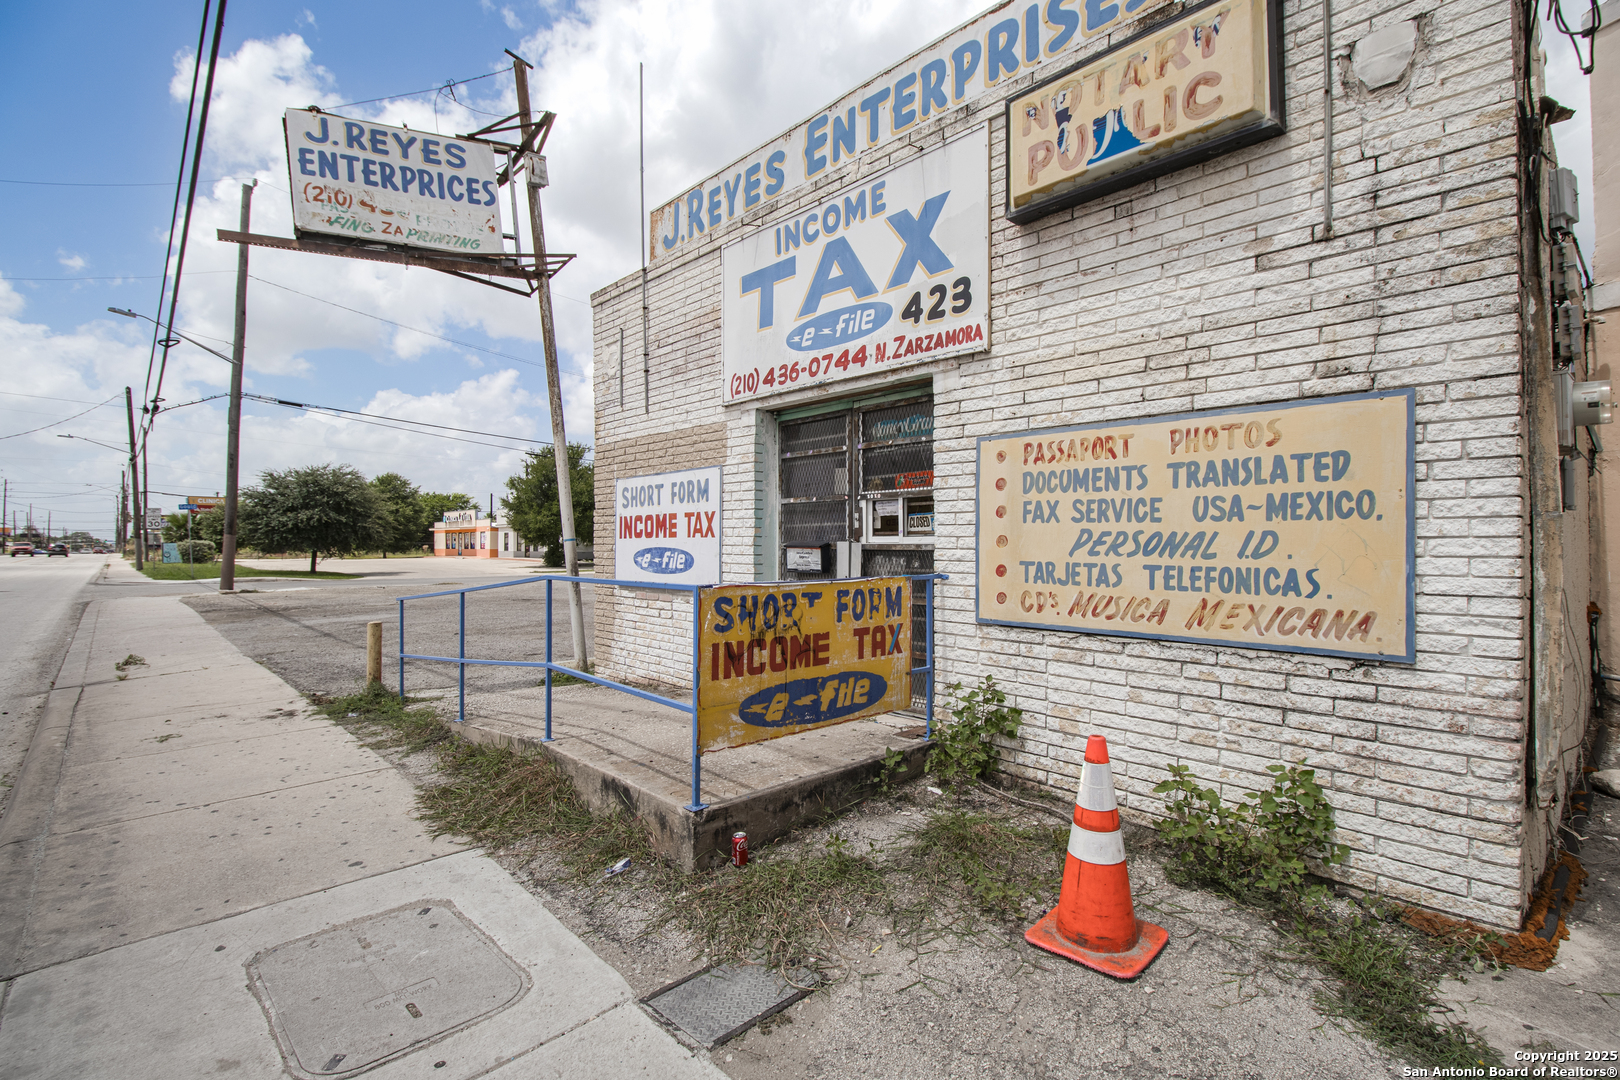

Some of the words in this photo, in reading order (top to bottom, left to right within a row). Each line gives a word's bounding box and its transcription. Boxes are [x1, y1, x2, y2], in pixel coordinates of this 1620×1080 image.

[804, 0, 1154, 179] ENTERPRISE
[1022, 6, 1231, 137] NOTARY
[1027, 71, 1223, 186] PULIC
[298, 147, 497, 207] ENTERPRICES
[775, 180, 887, 257] INCOME
[739, 190, 955, 333] TAX
[900, 276, 973, 327] 423
[1022, 433, 1135, 466] PASSAPORT
[1169, 417, 1283, 455] PHOTOS
[621, 483, 664, 509] SHORT
[671, 478, 710, 504] FORM
[1022, 464, 1149, 494] DOCUMENTS
[1166, 449, 1352, 489] TRANSLATED
[147, 520, 160, 528] 30
[619, 513, 678, 539] INCOME
[684, 511, 716, 538] TAX
[909, 516, 931, 529] CLOSED
[1022, 499, 1060, 524] FAX
[1070, 497, 1163, 524] SERVICE
[1068, 528, 1219, 560] PERSONAL
[1019, 560, 1123, 588] TARJETAS
[1142, 565, 1333, 600] TELEFONICAS.
[712, 591, 824, 635] SHORT
[1067, 590, 1170, 626] MUSICA
[711, 631, 830, 681] INCOME
[853, 623, 904, 660] TAX
